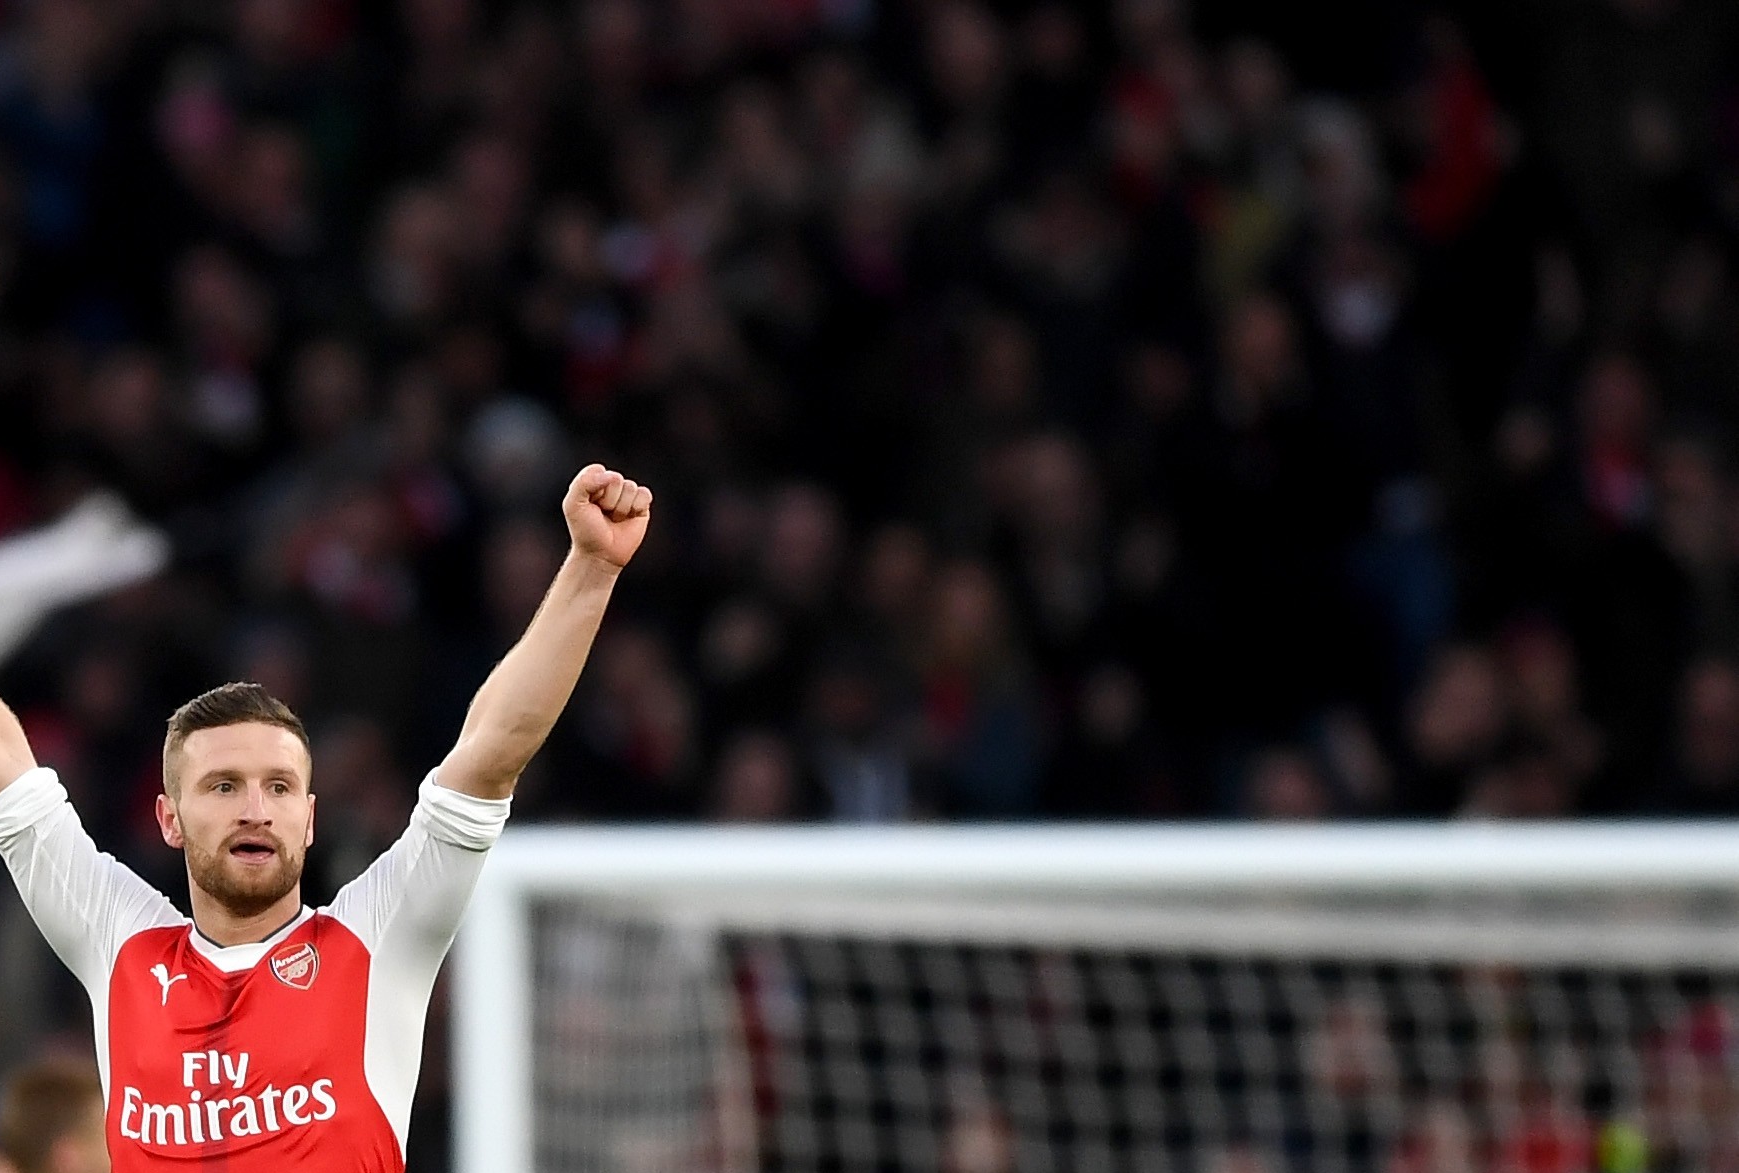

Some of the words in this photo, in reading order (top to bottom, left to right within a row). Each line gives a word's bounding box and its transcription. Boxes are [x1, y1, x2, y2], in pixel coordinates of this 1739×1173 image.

[275, 946, 311, 968] Arsenal
[182, 1050, 250, 1089] Fly
[121, 1078, 337, 1146] Emirates
